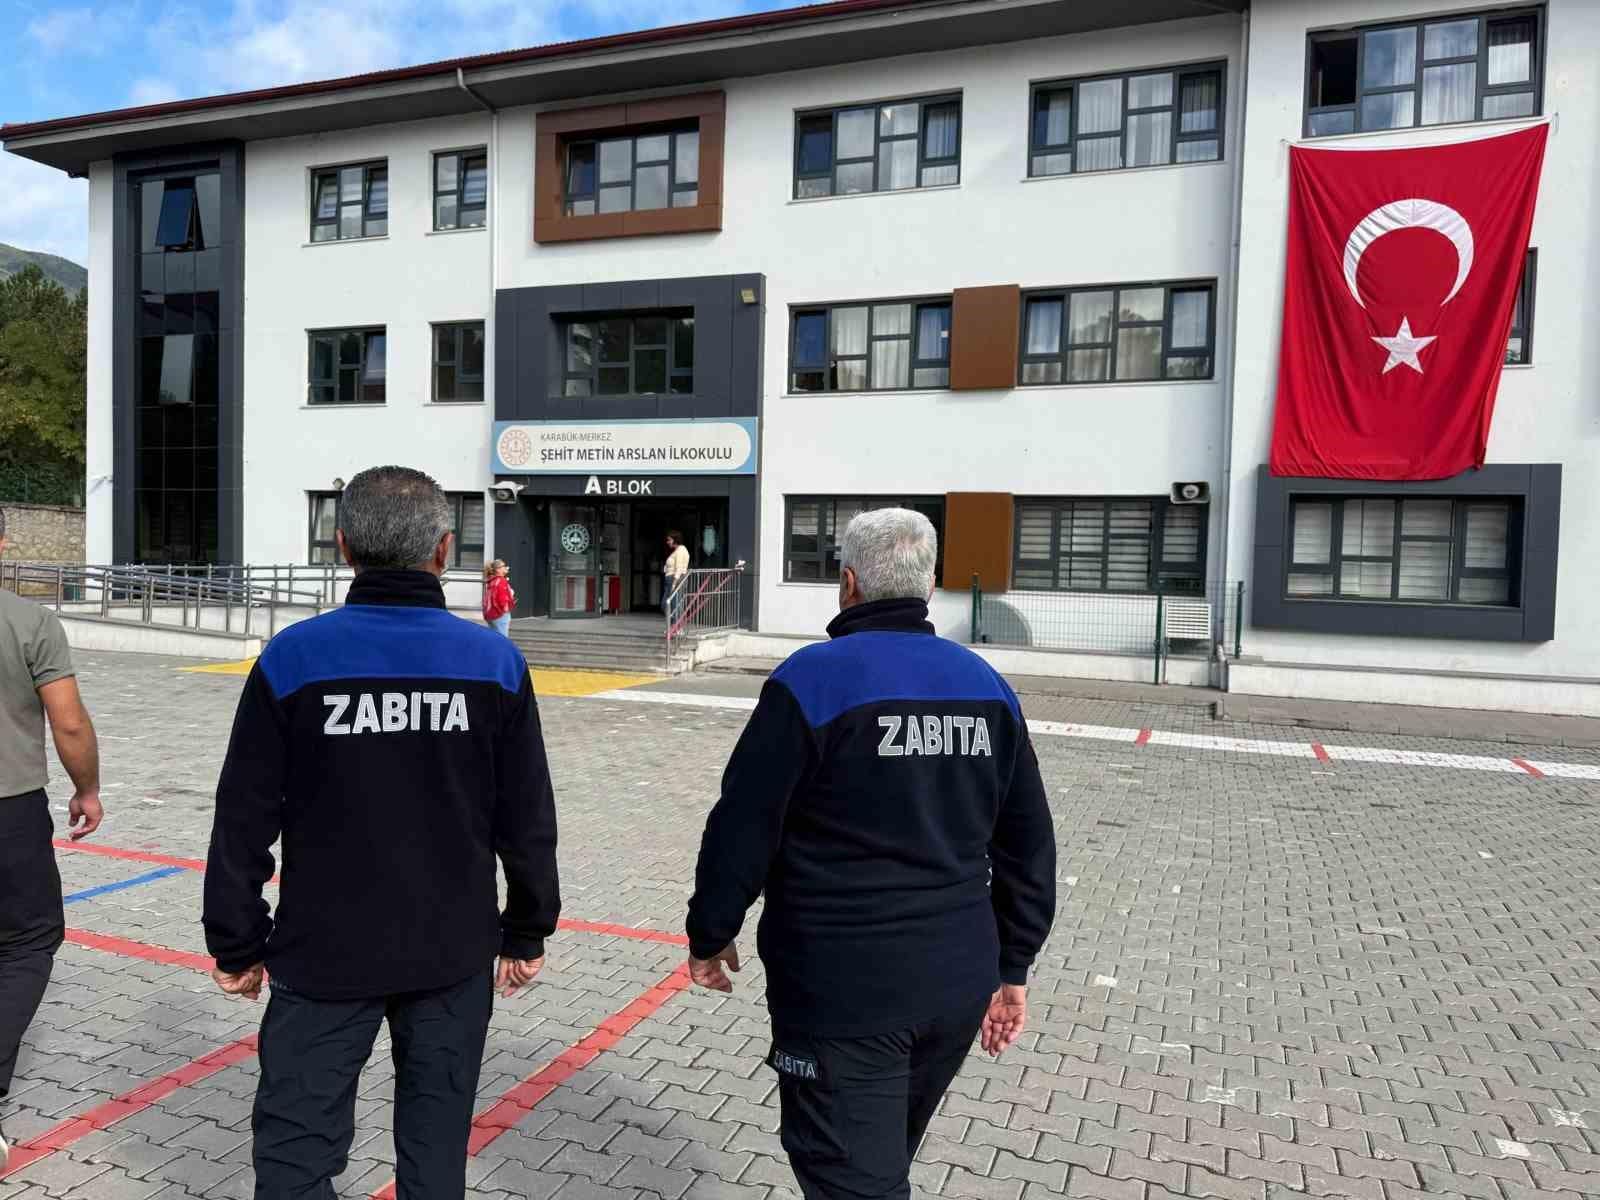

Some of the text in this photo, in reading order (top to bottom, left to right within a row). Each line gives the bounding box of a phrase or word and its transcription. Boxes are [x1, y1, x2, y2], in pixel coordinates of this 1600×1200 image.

[540, 445, 732, 464] ŞEHİT METİN ARSLAN İLKOKULU
[584, 475, 653, 495] A BLOK
[323, 691, 470, 735] ZABITA
[878, 715, 992, 757] ZABITA
